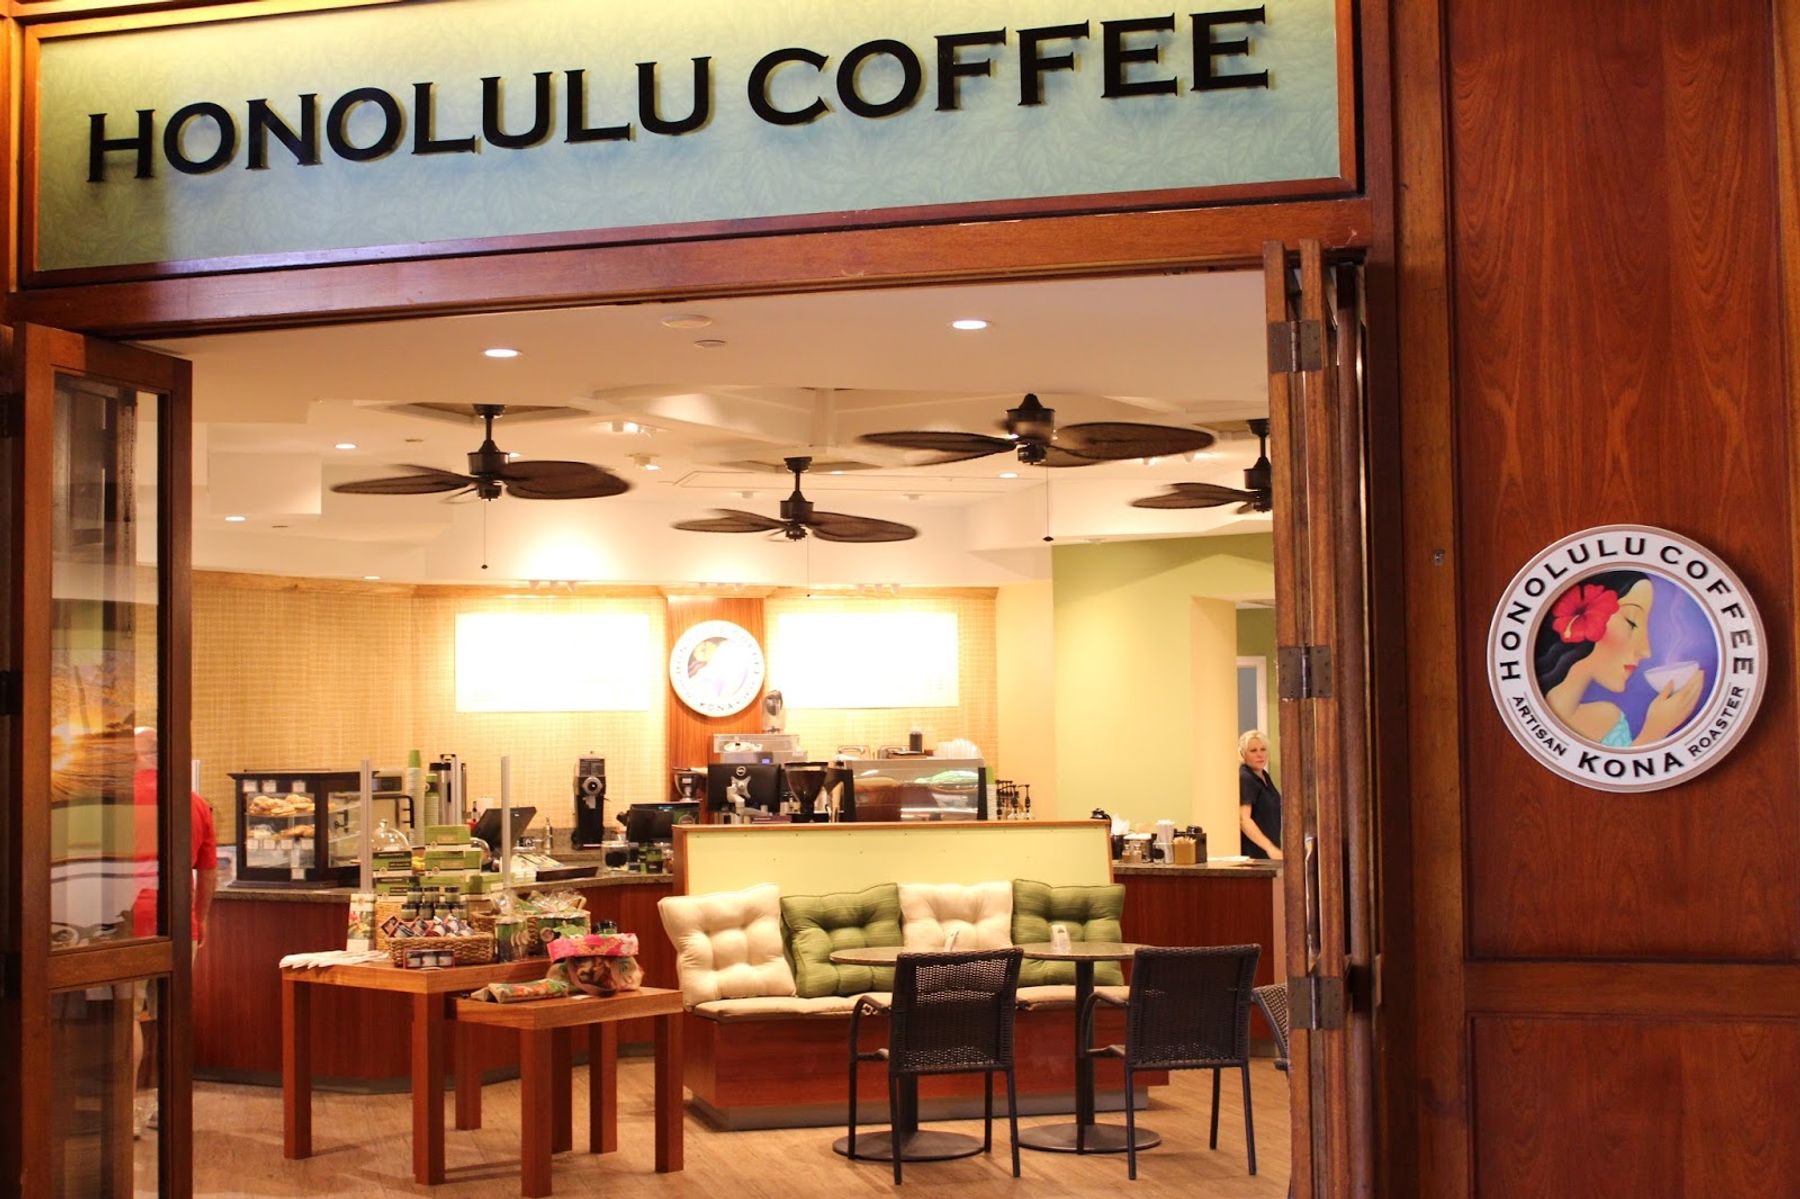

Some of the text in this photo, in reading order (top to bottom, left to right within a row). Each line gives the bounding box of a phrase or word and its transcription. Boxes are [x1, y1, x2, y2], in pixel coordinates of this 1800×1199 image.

[87, 4, 1269, 184] HONOLULU COFFEE
[1499, 537, 1754, 681] HONOLULU COFFEE
[1512, 685, 1744, 778] ARTISAN KONA ROASTER
